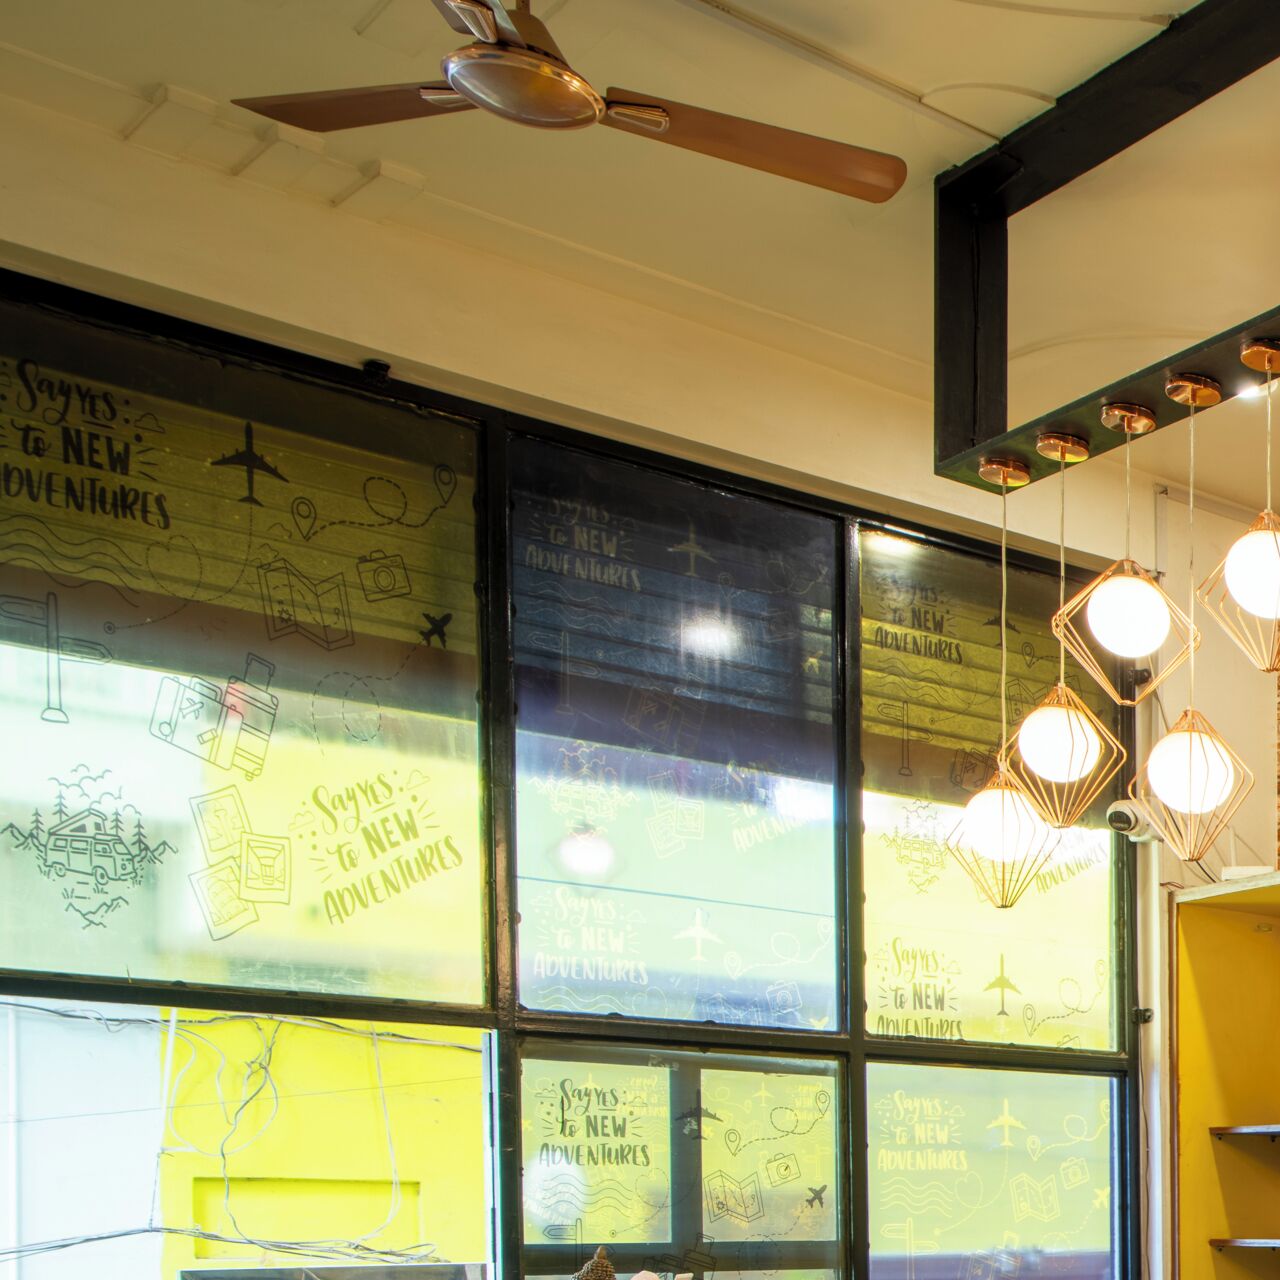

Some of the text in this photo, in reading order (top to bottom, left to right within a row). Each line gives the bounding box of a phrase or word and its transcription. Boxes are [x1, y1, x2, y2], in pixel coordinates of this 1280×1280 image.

[17, 358, 117, 425] Say YES
[11, 418, 131, 475] to NEW
[0, 462, 171, 530] DVENTURES
[574, 525, 617, 558] NEW
[911, 606, 944, 634] NEW
[875, 626, 963, 665] ADVENTURES
[312, 773, 393, 835] Say YES
[326, 808, 419, 872] to NEW
[323, 835, 463, 925] ADVENTURES
[581, 926, 625, 953] NEW
[533, 952, 649, 985] ADVENTURES
[892, 937, 917, 983] Say
[889, 982, 945, 1011] to NEW
[559, 1079, 594, 1116] Say
[594, 1088, 619, 1107] YES
[893, 1089, 919, 1124] Say
[556, 1115, 627, 1138] to NEW
[891, 1123, 948, 1145] to NEW
[539, 1143, 650, 1168] ADVENTURES
[877, 1148, 968, 1172] ADVENTURES
